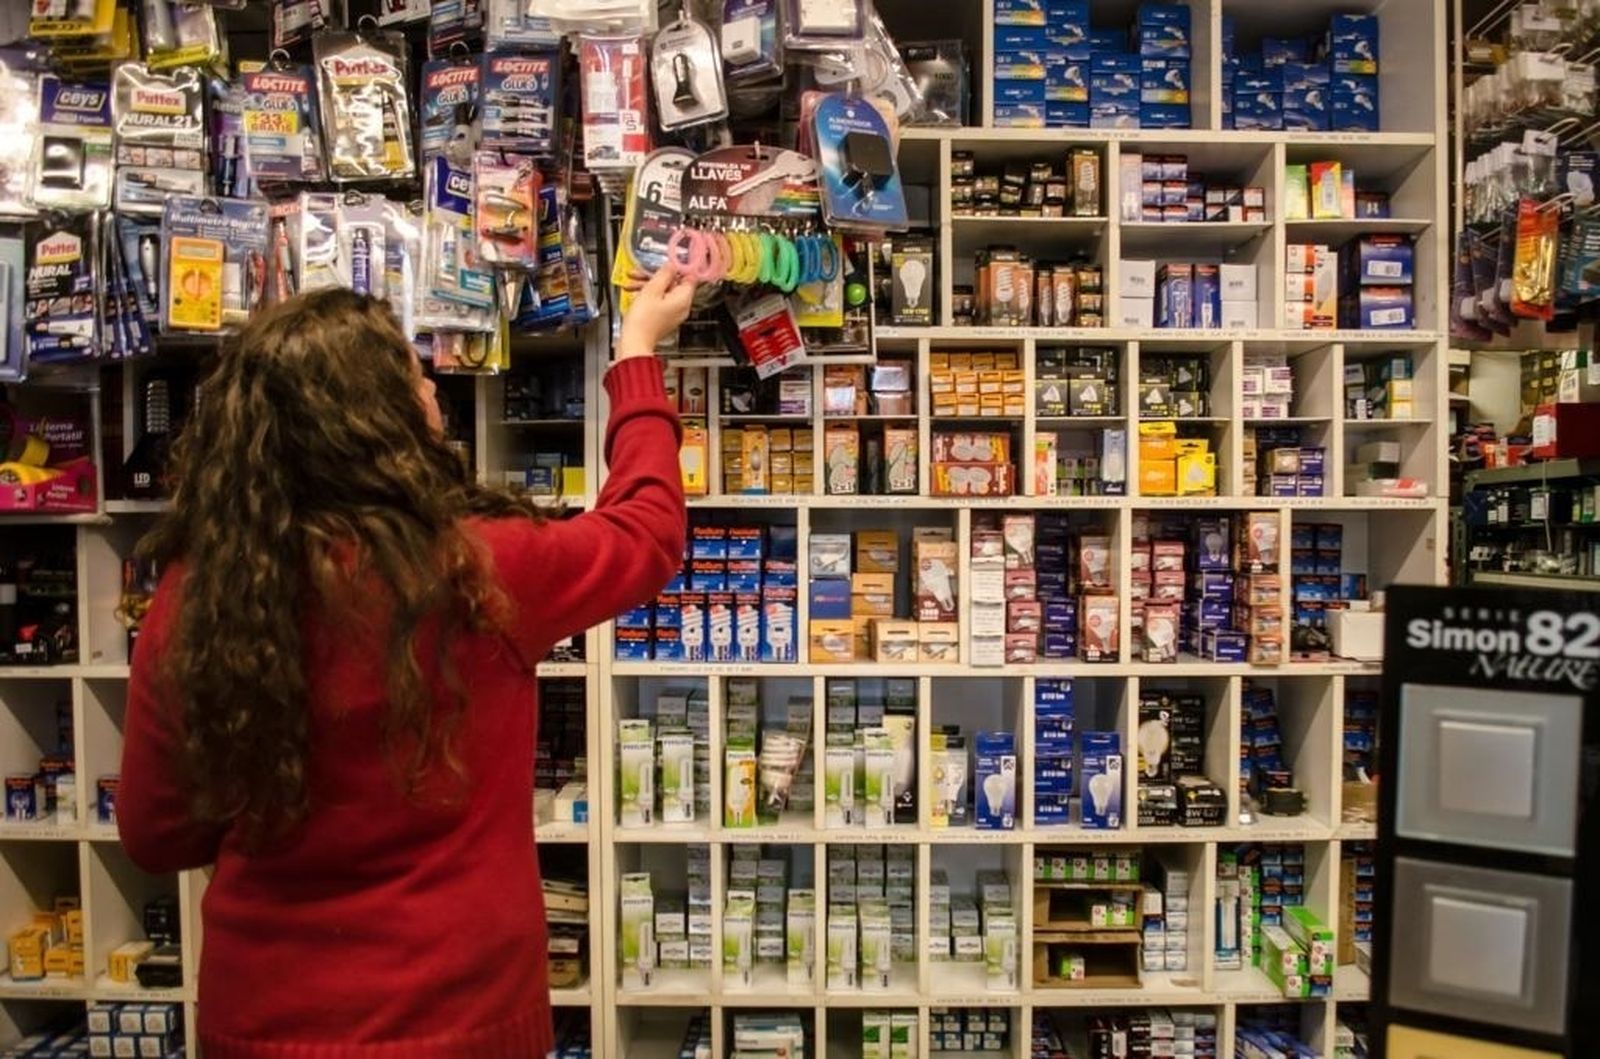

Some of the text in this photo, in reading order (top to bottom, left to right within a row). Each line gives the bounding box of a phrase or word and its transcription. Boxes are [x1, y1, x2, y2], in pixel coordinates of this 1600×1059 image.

[690, 166, 743, 181] LLAVES
[645, 180, 664, 206] 6
[688, 194, 729, 211] ALFA
[1407, 610, 1600, 659] Simon 82
